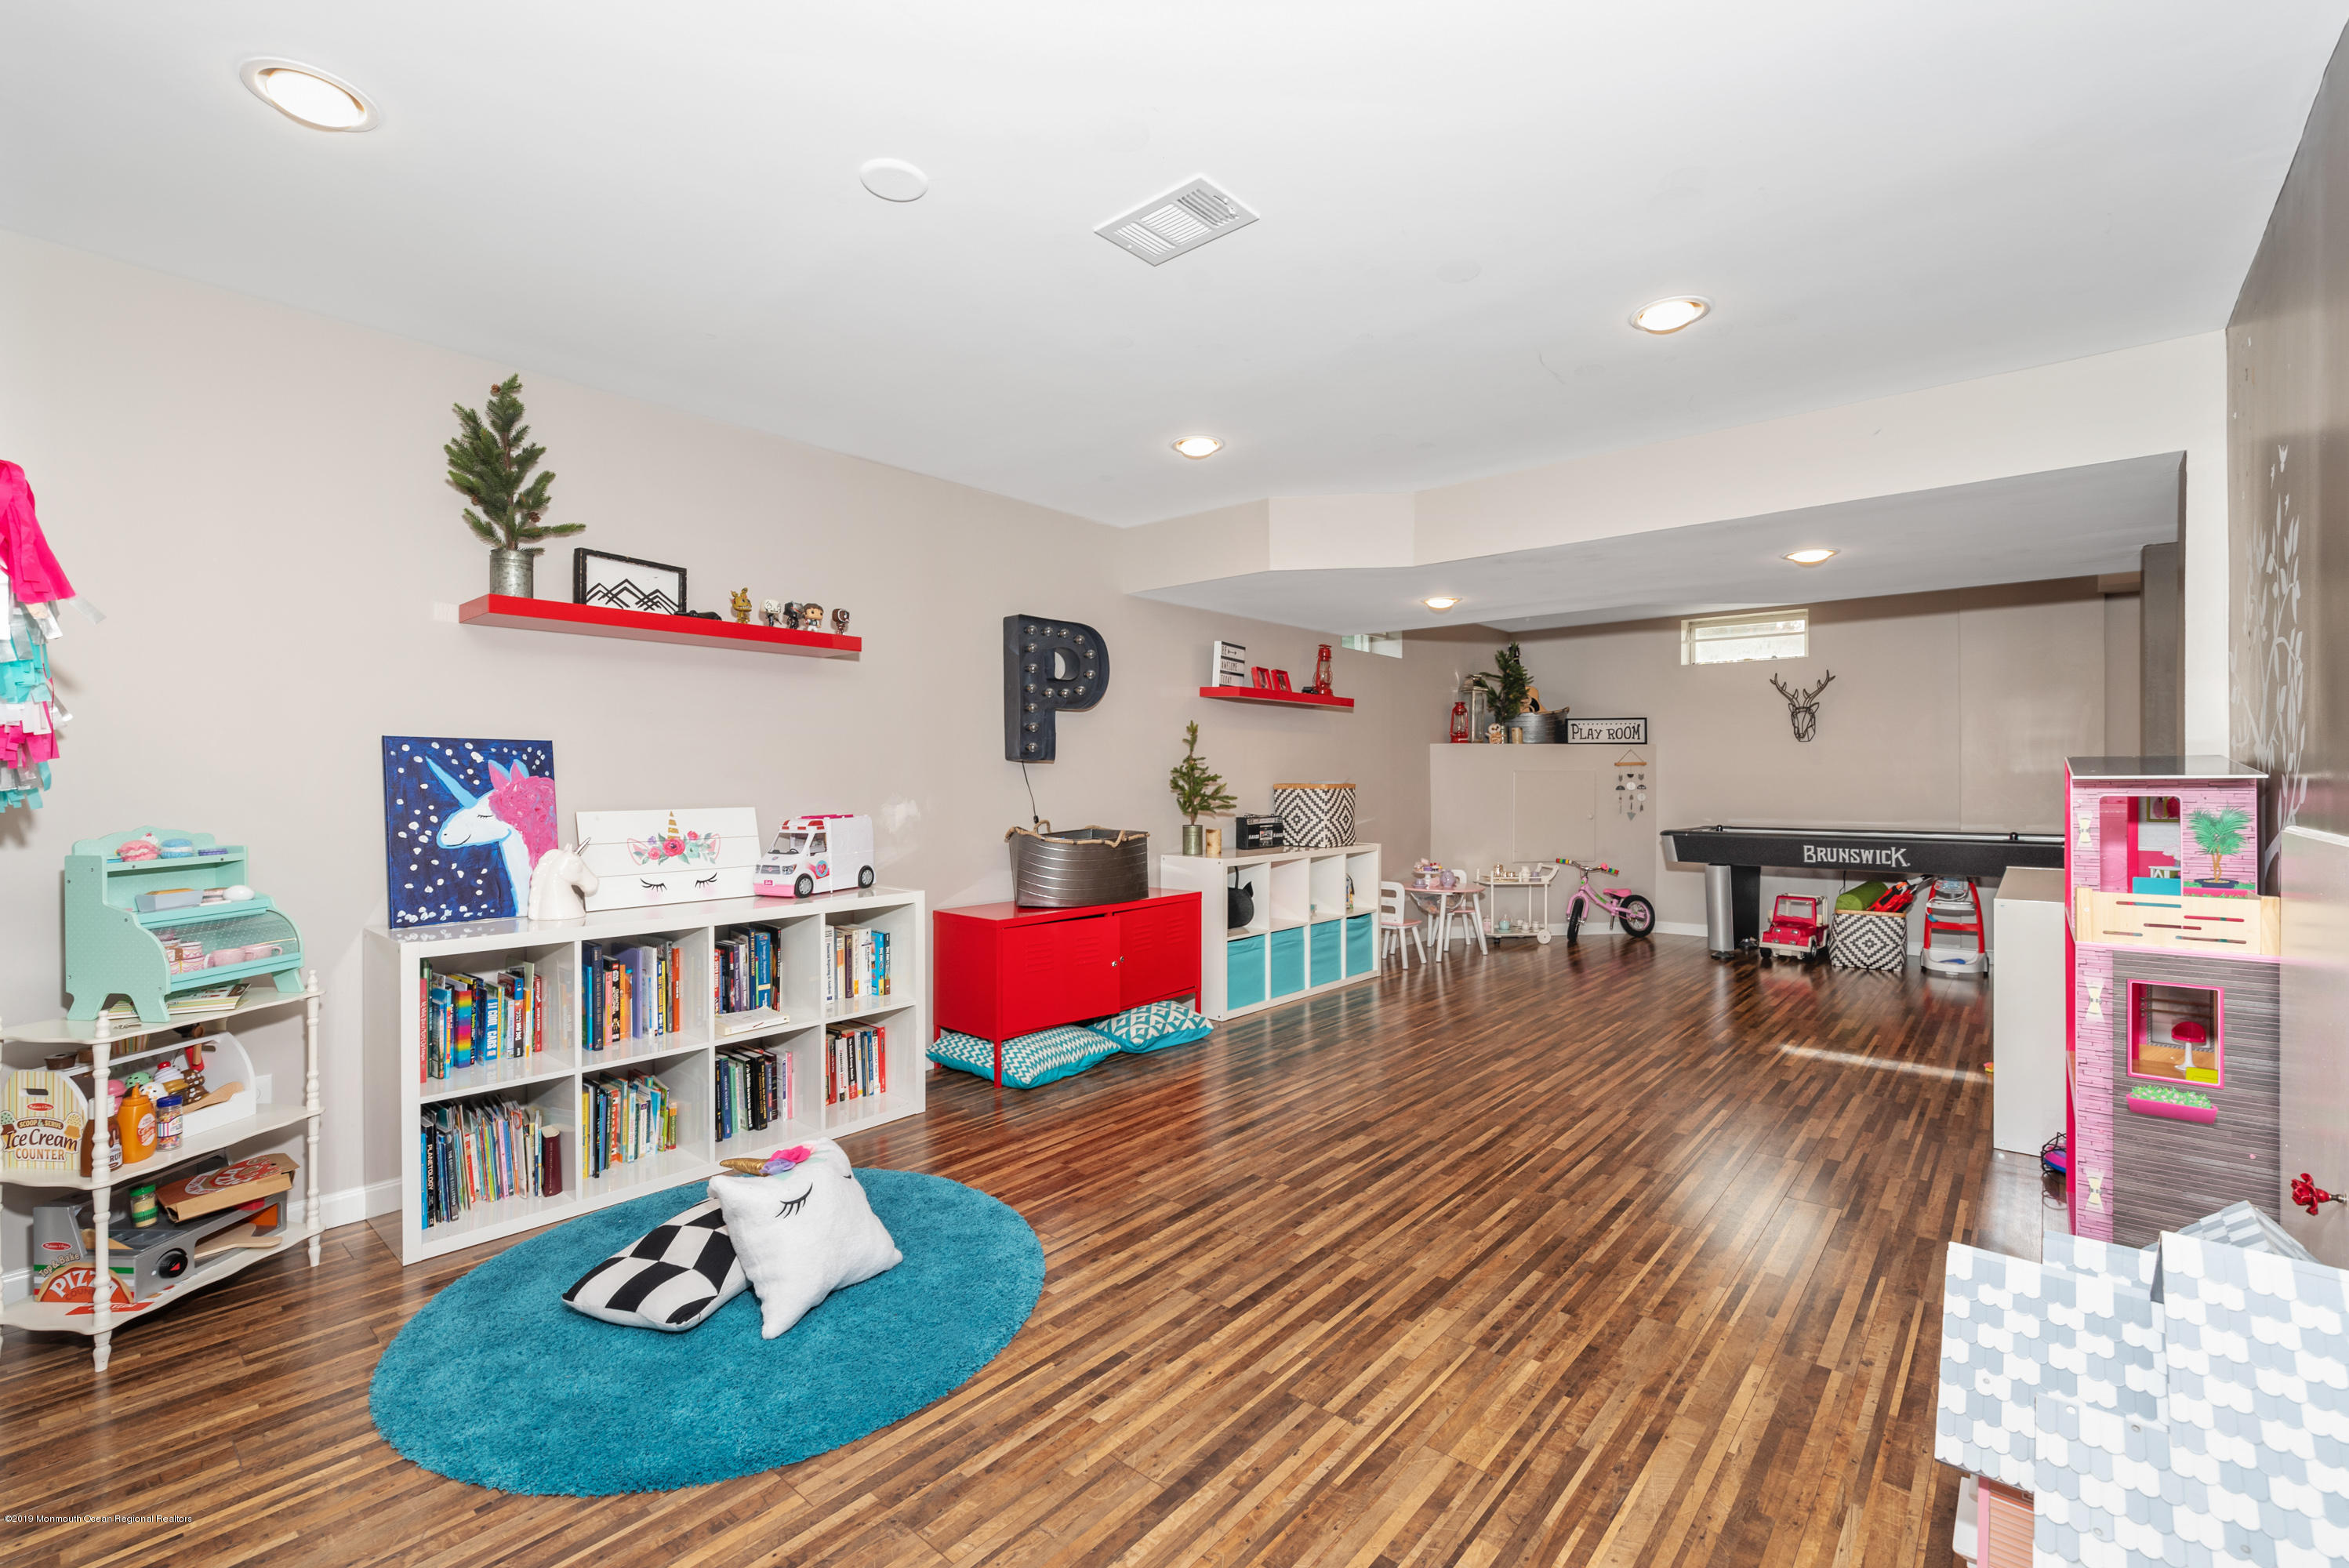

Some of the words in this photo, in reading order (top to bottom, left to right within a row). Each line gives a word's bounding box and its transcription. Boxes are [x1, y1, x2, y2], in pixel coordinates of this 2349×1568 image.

[1221, 645, 1227, 655] BE
[1221, 661, 1238, 672] AWESOME
[1221, 674, 1233, 684] TODAY
[1004, 614, 1109, 764] P
[1570, 723, 1603, 740] PLAY
[1606, 724, 1641, 740] ROOM
[1803, 845, 1908, 867] BRUNSWICK
[488, 1010, 498, 1027] COOL
[487, 1030, 498, 1049] CARS
[19, 1120, 38, 1128] SCOOP
[45, 1120, 63, 1129] SERVE
[5, 1130, 27, 1149] Ice
[29, 1128, 78, 1151] Cream
[15, 1148, 65, 1160] COUNTER
[38, 1265, 53, 1278] Top
[58, 1253, 80, 1264] Bake
